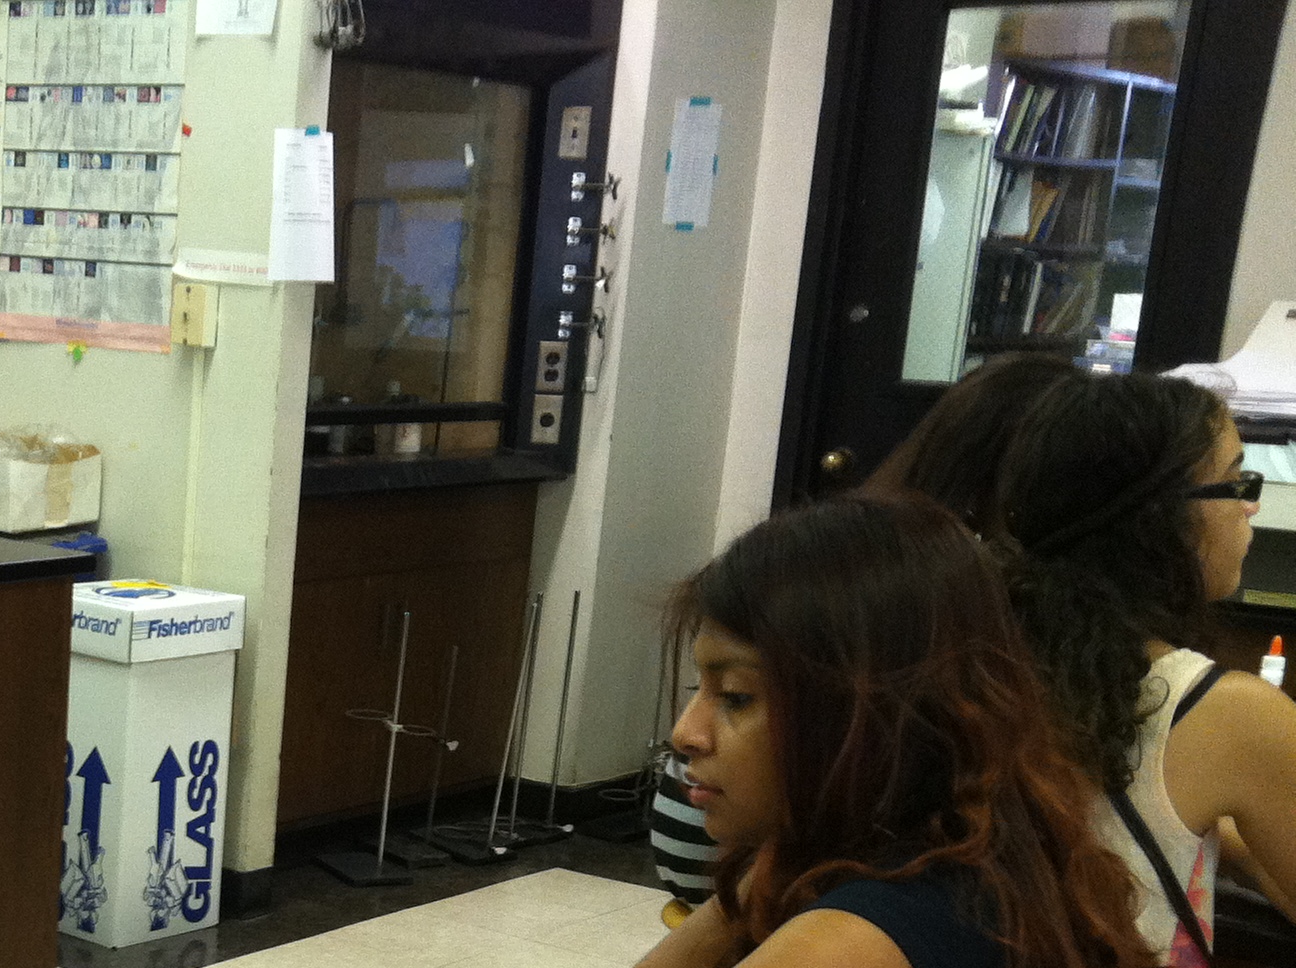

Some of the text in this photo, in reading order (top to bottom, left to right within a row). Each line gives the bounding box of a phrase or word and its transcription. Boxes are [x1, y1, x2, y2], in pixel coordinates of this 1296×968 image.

[71, 611, 118, 636] rbrand
[148, 612, 232, 639] Fisherbrand
[181, 739, 220, 923] GLASS
